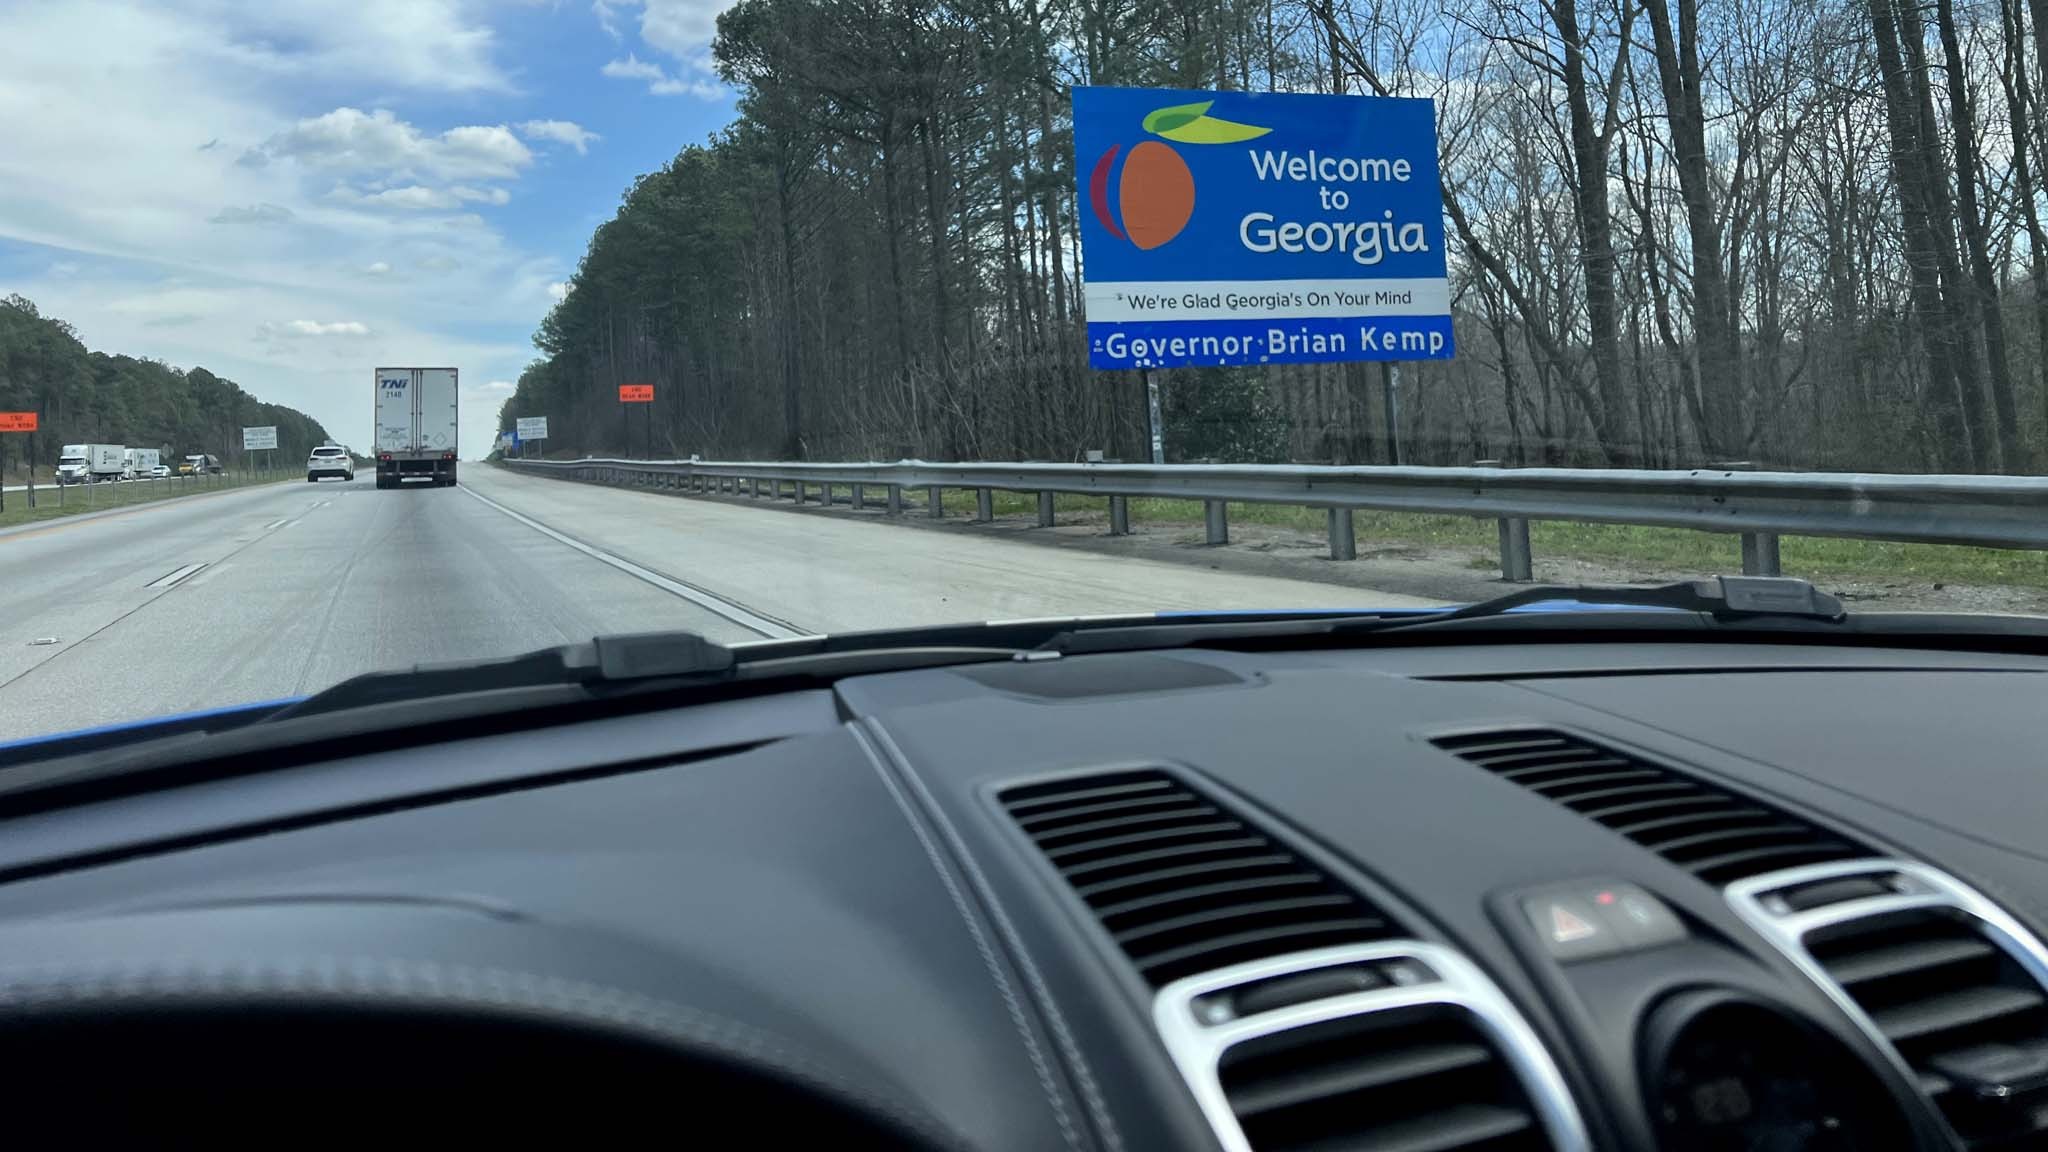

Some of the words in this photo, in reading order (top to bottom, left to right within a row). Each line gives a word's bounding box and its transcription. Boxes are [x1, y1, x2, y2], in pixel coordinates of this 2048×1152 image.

[1249, 150, 1411, 182] Welcome
[1320, 186, 1349, 209] to
[1239, 210, 1429, 264] Georgia
[1128, 295, 1177, 309] We're
[1182, 293, 1221, 308] Glad
[1226, 292, 1302, 311] Georgia's
[1307, 292, 1330, 306] On
[1335, 291, 1370, 306] Your
[1375, 291, 1412, 305] Mind
[1106, 332, 1253, 358] Governor
[1268, 327, 1346, 355] Brian
[1360, 326, 1443, 355] Kemp
